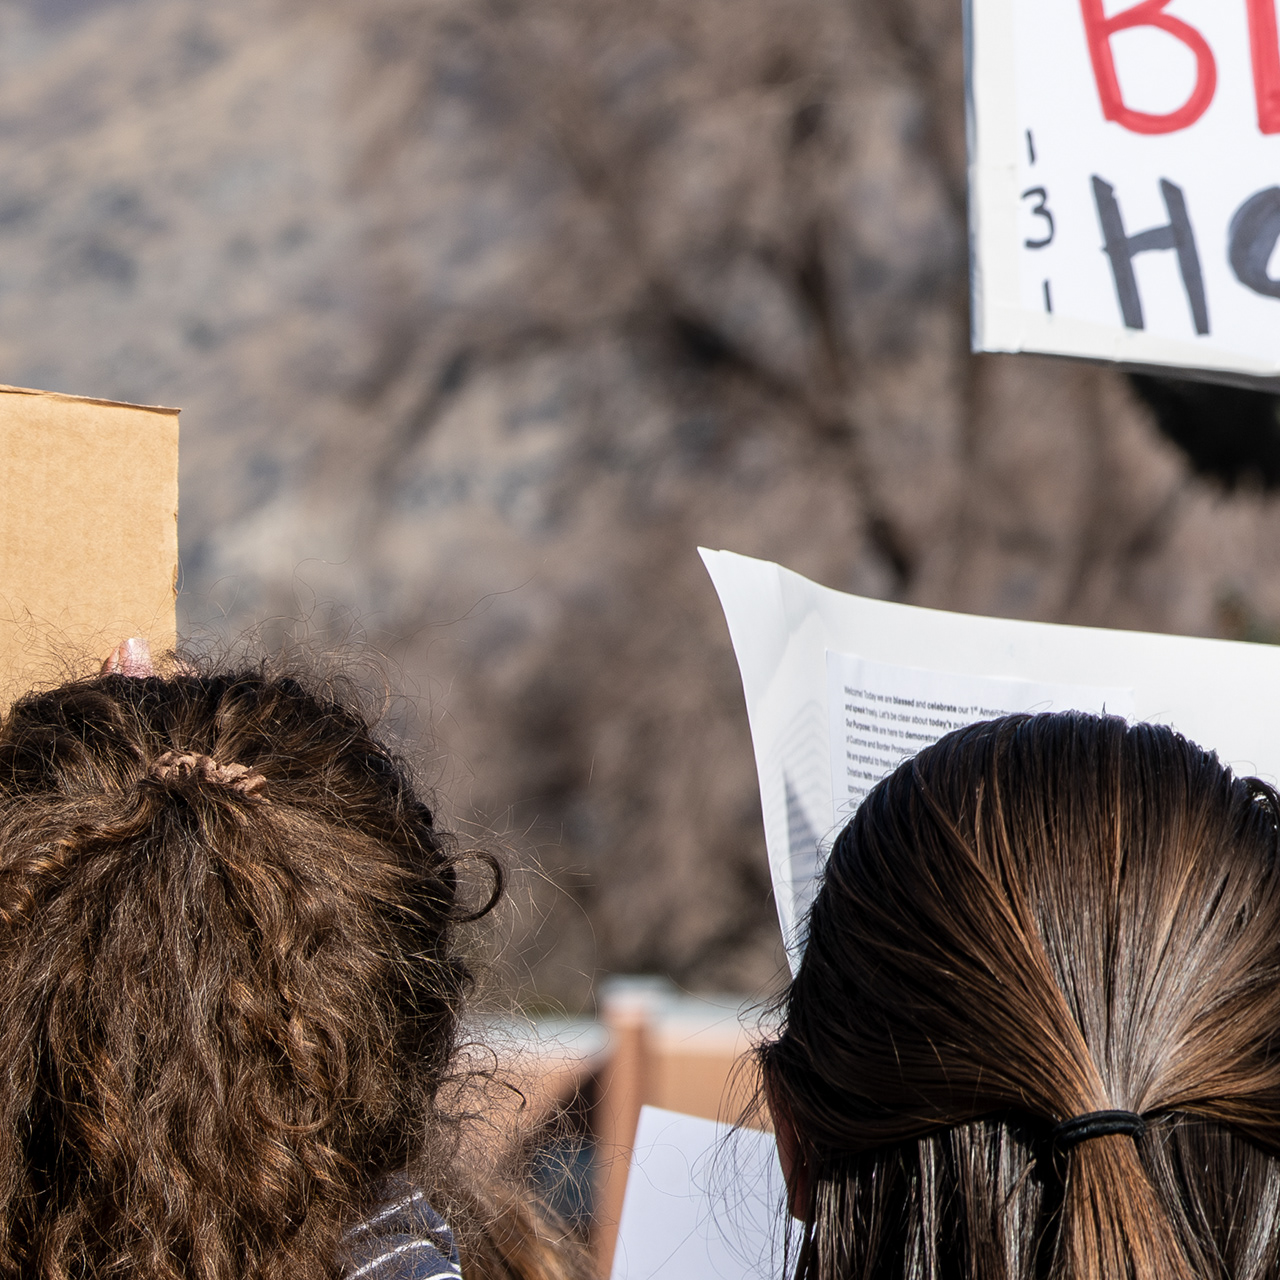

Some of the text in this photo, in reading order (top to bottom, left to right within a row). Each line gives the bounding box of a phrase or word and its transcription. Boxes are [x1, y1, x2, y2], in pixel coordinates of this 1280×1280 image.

[916, 700, 926, 709] and
[927, 702, 957, 714] celebrate
[958, 706, 968, 715] our
[912, 715, 928, 725] about
[929, 718, 952, 730] today's
